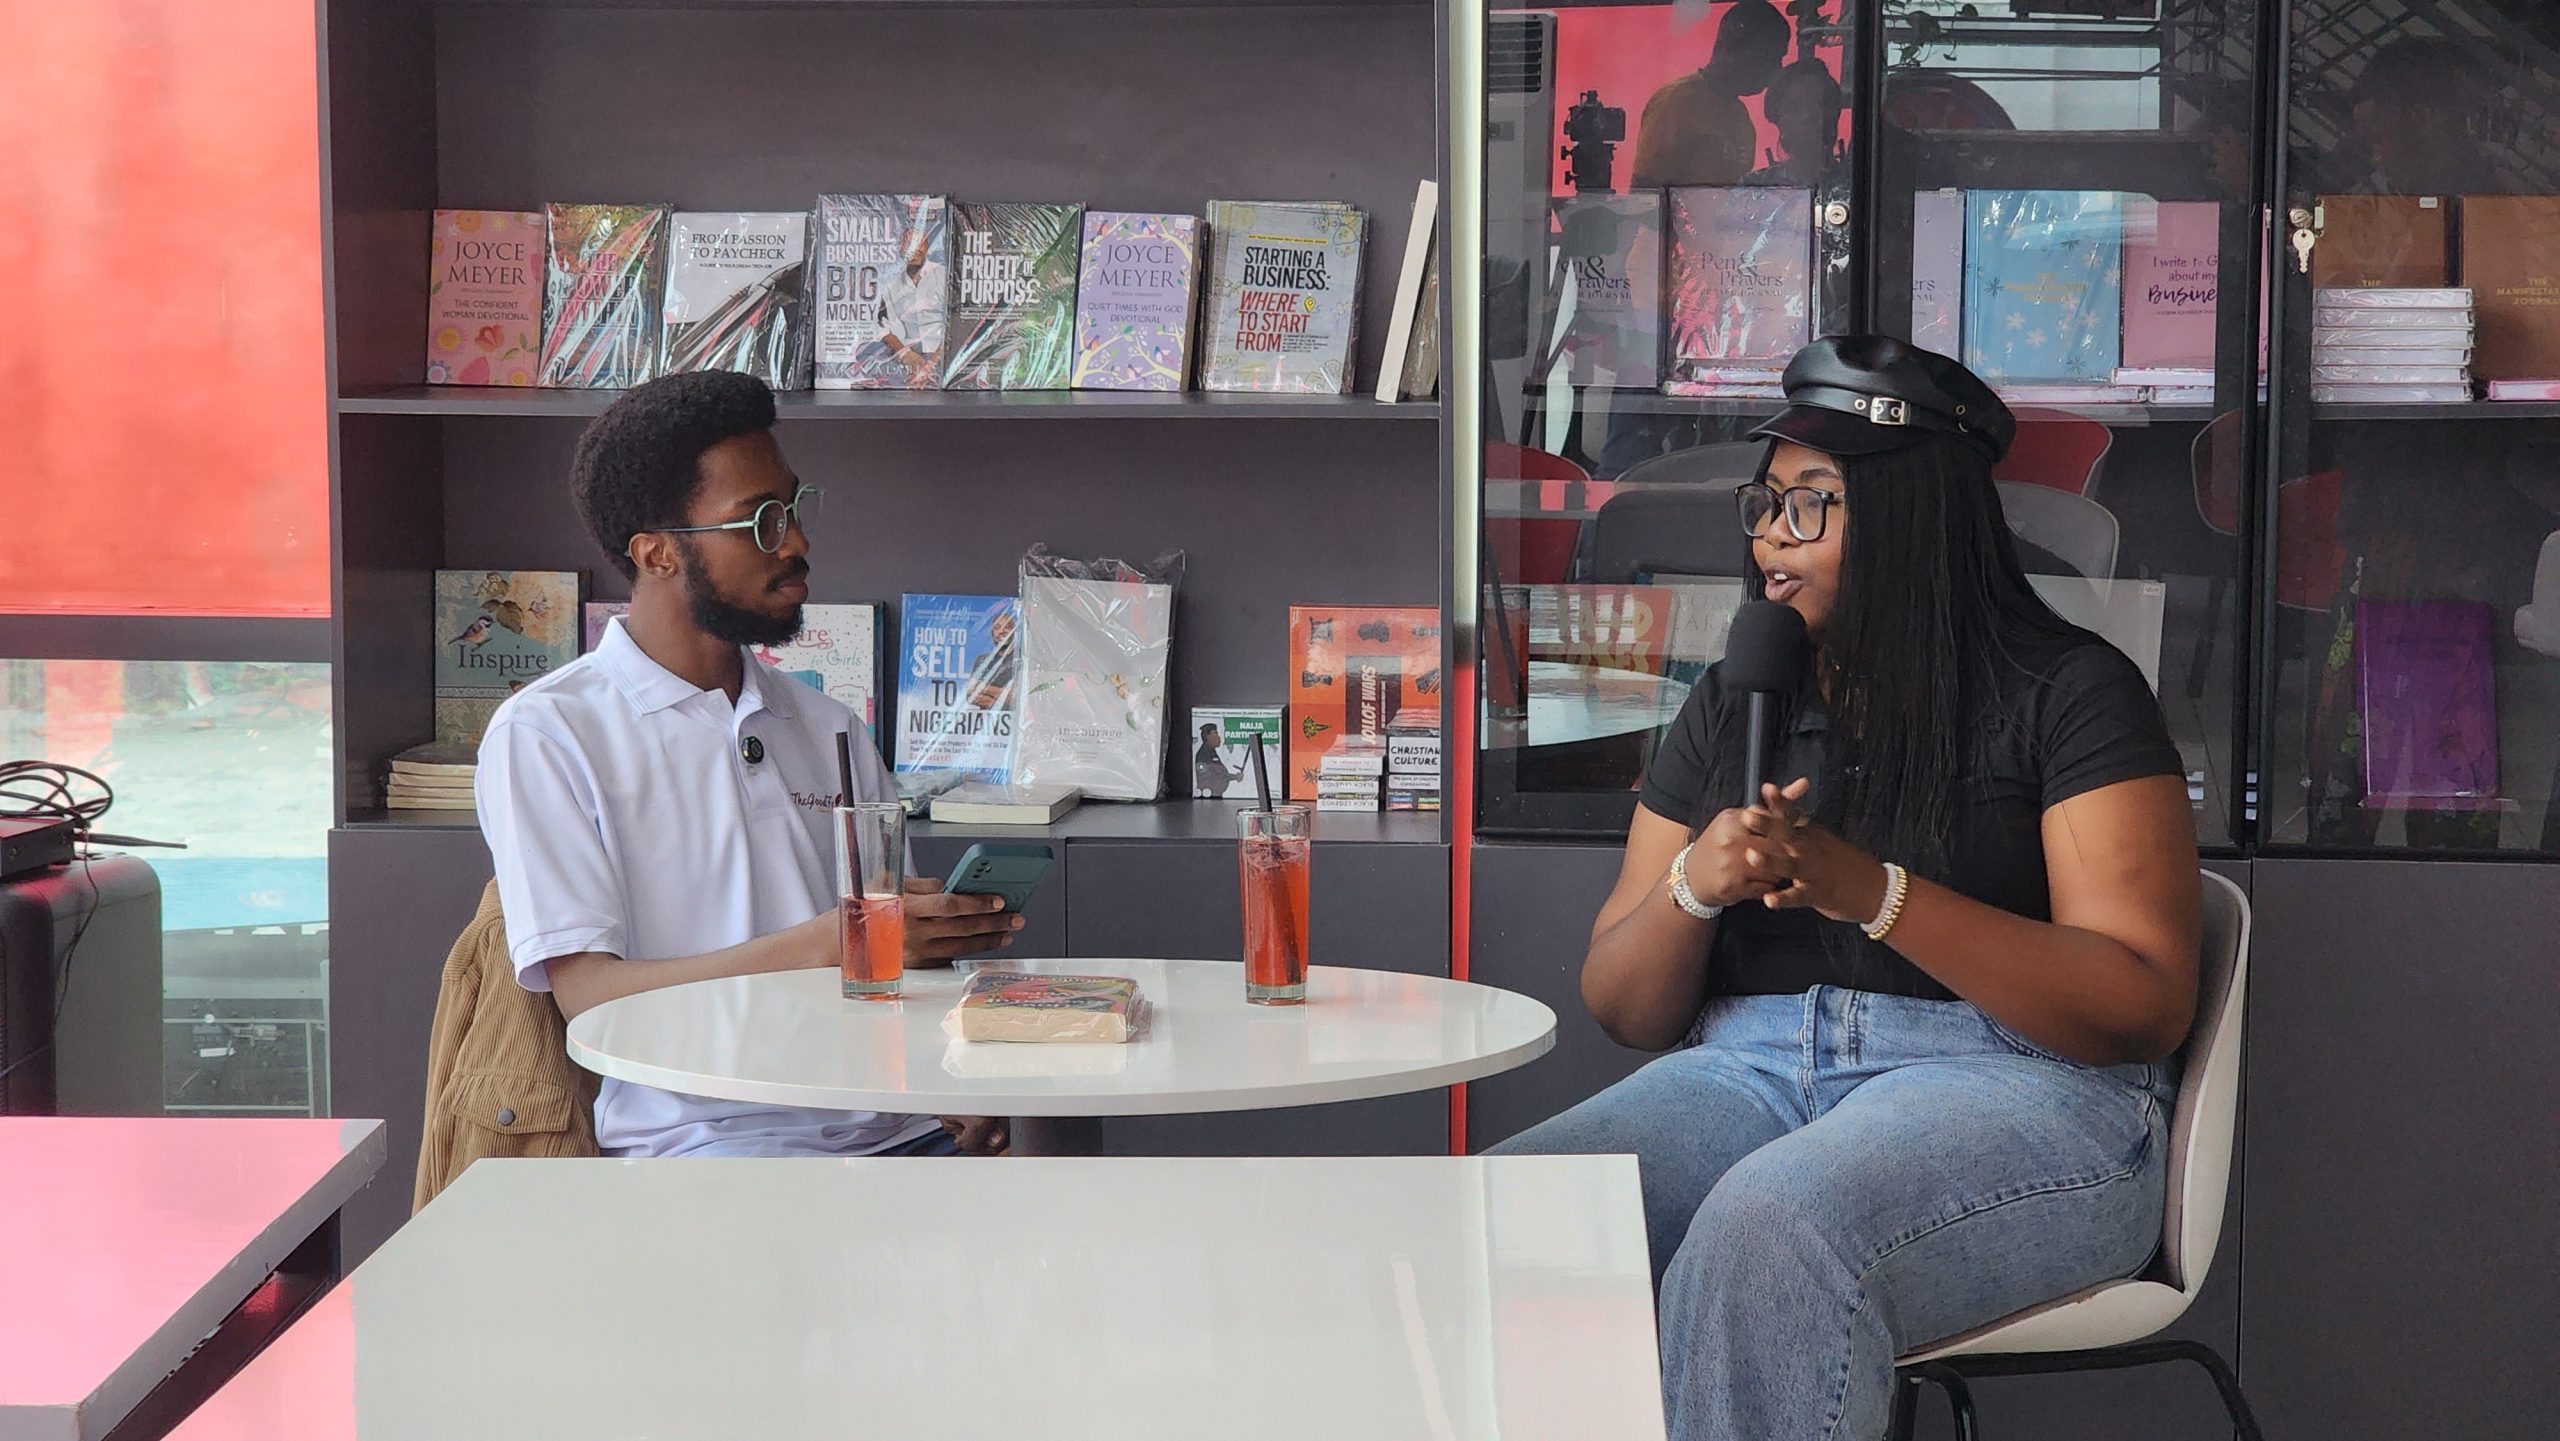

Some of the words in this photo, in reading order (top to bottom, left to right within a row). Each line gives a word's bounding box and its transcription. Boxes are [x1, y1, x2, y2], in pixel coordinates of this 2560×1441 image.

[692, 233, 729, 245] FROM
[732, 234, 786, 245] PASSION
[825, 215, 896, 244] SMALL
[454, 240, 525, 262] JOYCE
[963, 231, 993, 254] THE
[690, 247, 710, 258] TO
[713, 248, 785, 259] PAYCHECK
[826, 244, 897, 264] BUSINESS
[1106, 245, 1175, 266] JOYCE
[1244, 246, 1312, 268] STARTING
[1316, 251, 1325, 269] A
[1702, 252, 1736, 270] Pen
[2153, 256, 2157, 268] I
[2159, 256, 2187, 268] write
[448, 265, 526, 285] MEYER
[962, 255, 1020, 280] PROFIT
[1023, 260, 1036, 276] OF
[2168, 270, 2199, 281] about
[2202, 272, 2216, 285] my
[826, 265, 878, 301] BIG
[1099, 269, 1175, 288] MEYER
[1243, 265, 1331, 291] BUSINESS:
[1574, 277, 1631, 292] rayers
[2528, 277, 2548, 286] THE
[454, 299, 470, 308] THE
[473, 300, 519, 309] CONFIDENT
[1088, 302, 1110, 311] QUIET
[1115, 303, 1138, 312] TIMES
[1142, 304, 1161, 312] WITH
[1164, 305, 1183, 313] GOD
[1239, 290, 1300, 312] WHERE
[442, 310, 475, 319] WOMAN
[478, 311, 529, 321] DEVOTIONAL
[825, 303, 876, 321] MONEY
[1110, 314, 1161, 323] DEVOTIONAL
[1239, 311, 1257, 331] TO
[1261, 314, 1311, 333] START
[1236, 332, 1281, 352] FROM
[914, 627, 947, 645] HOW
[951, 628, 967, 646] TO
[458, 644, 549, 677] Inspire
[826, 649, 862, 666] Girls
[911, 645, 970, 678] SELL
[1361, 664, 1376, 701] WARS
[931, 680, 958, 706] TO
[909, 710, 1012, 737] NIGERIANS
[1239, 722, 1264, 730] NAIJA
[1361, 702, 1376, 745] JOLLOF
[1225, 731, 1279, 739] PARTICARS
[1393, 757, 1438, 765] CULTURE
